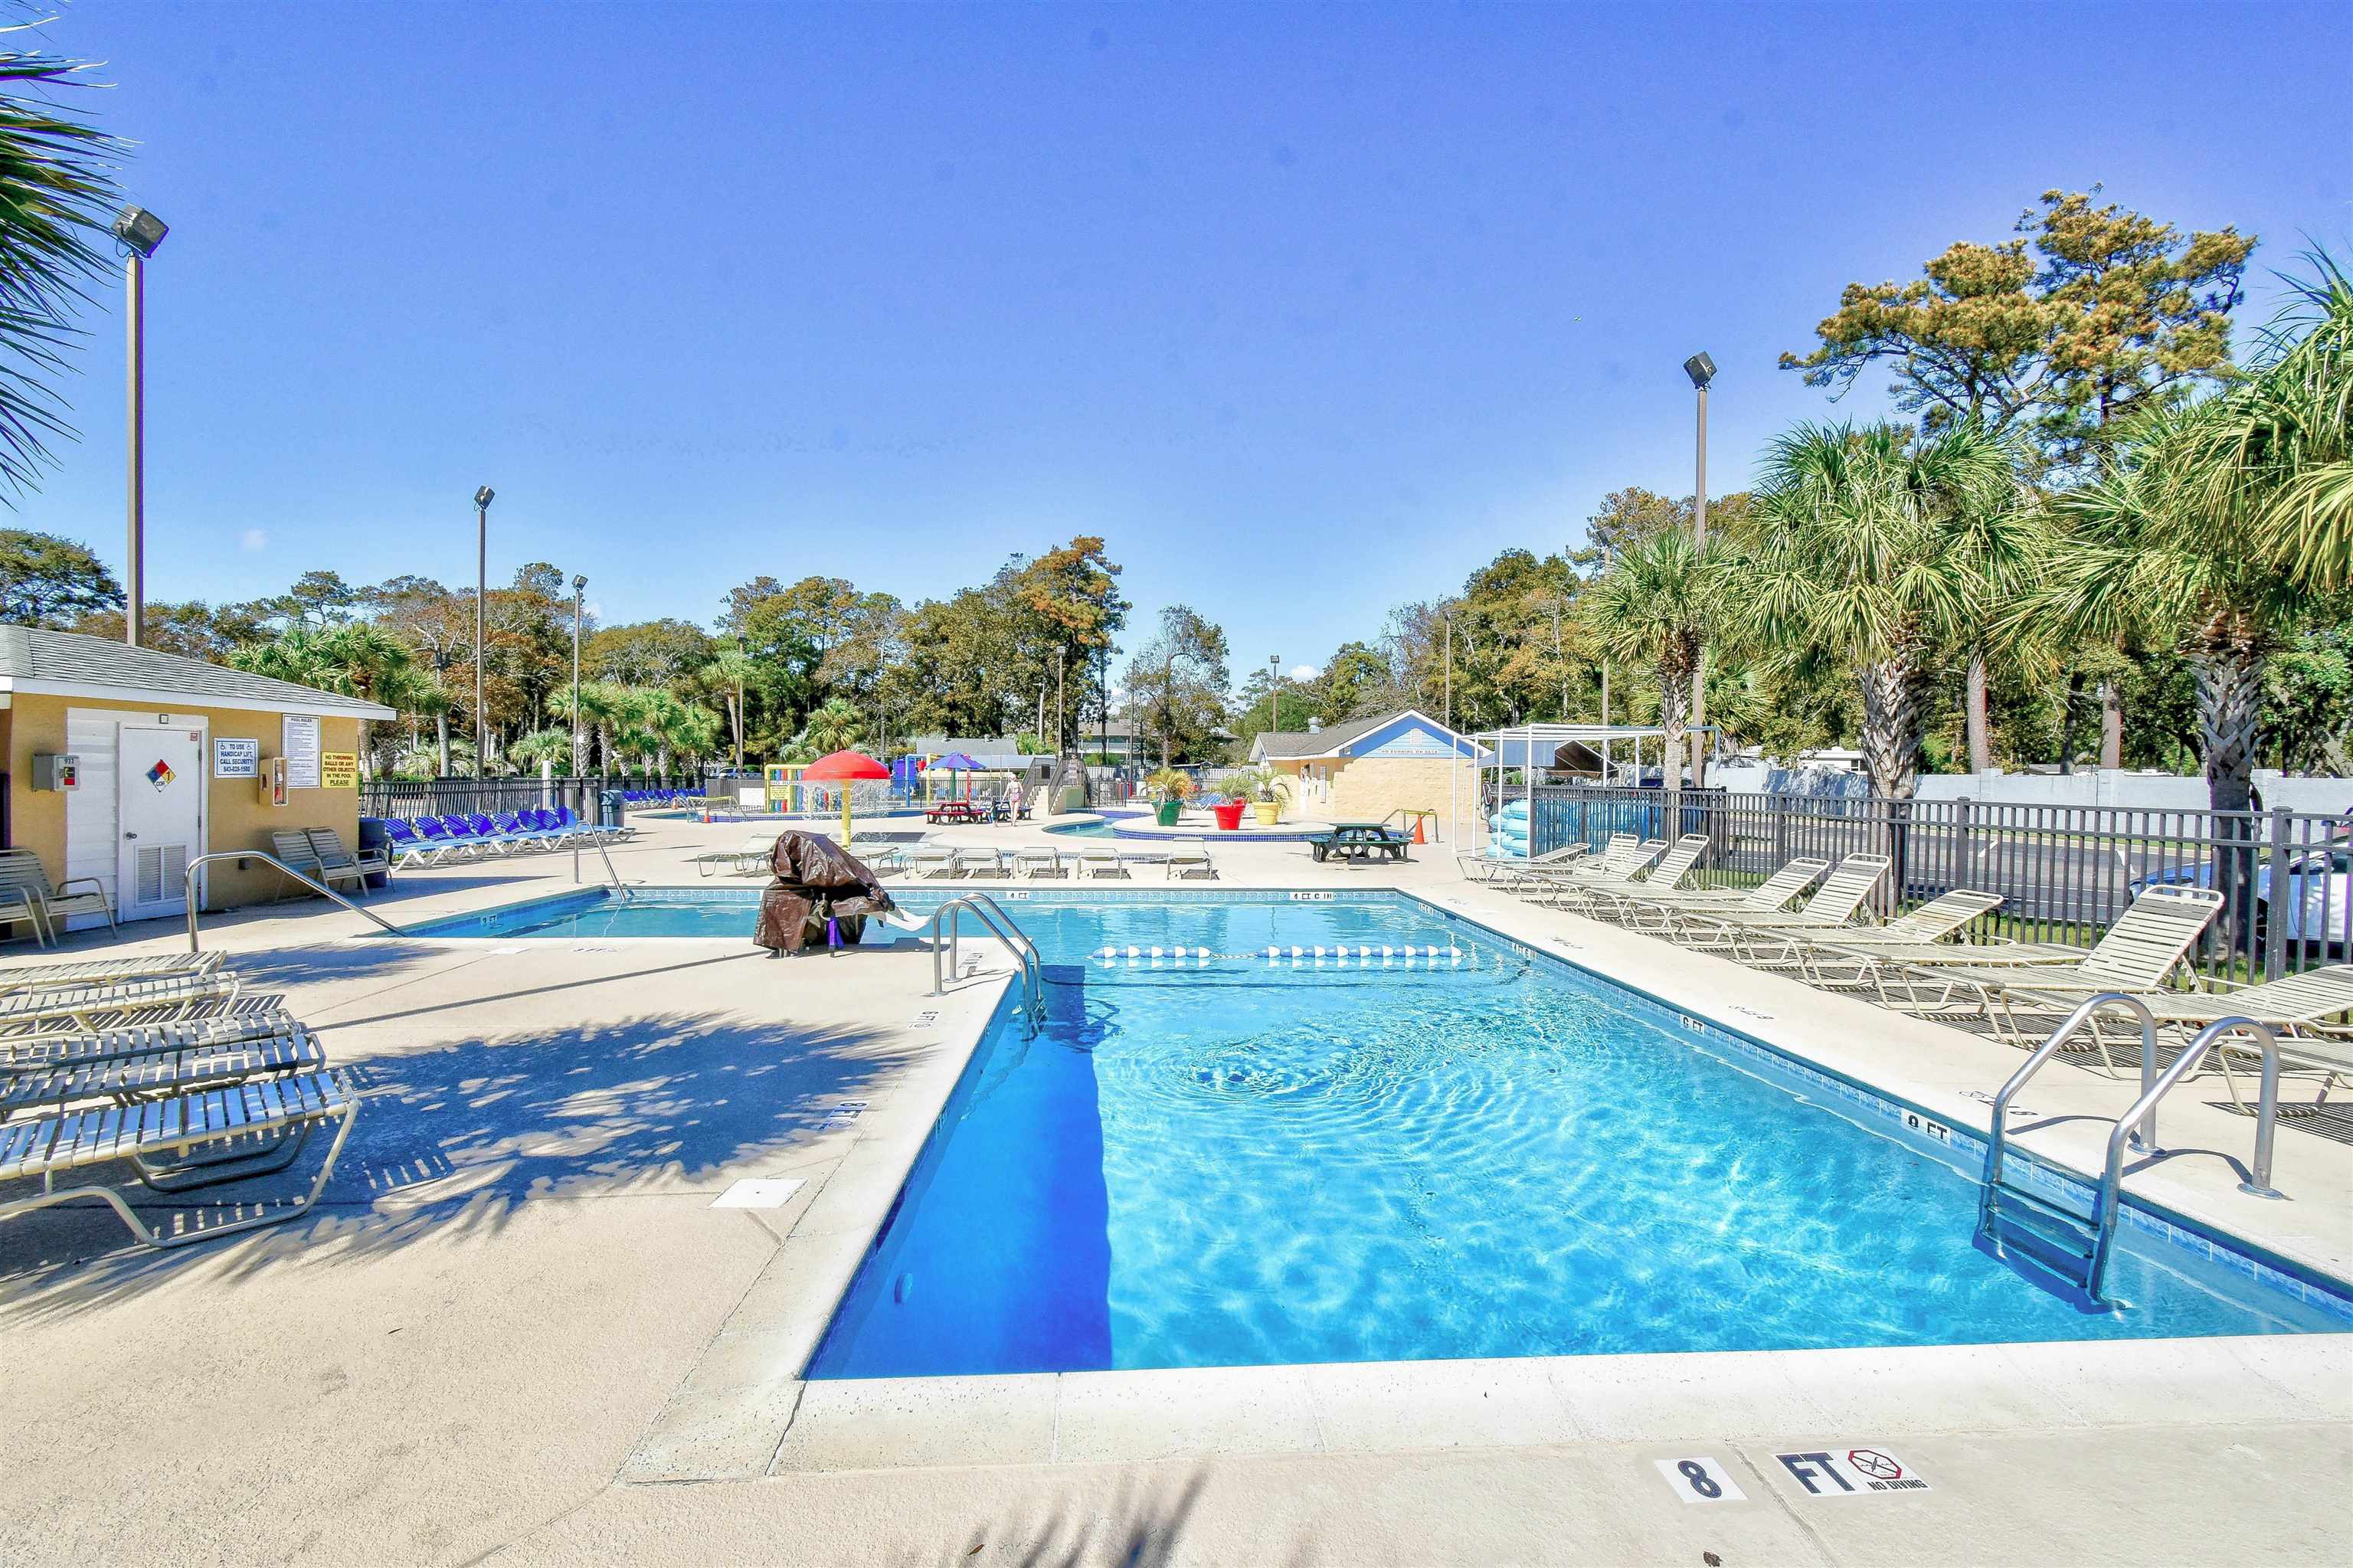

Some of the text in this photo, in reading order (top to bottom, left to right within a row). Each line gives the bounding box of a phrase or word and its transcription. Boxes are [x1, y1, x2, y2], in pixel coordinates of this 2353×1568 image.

[1926, 1121, 1948, 1140] FT
[1677, 1452, 1855, 1499] 8 FT
[1867, 1479, 1929, 1491] NO DIVING
